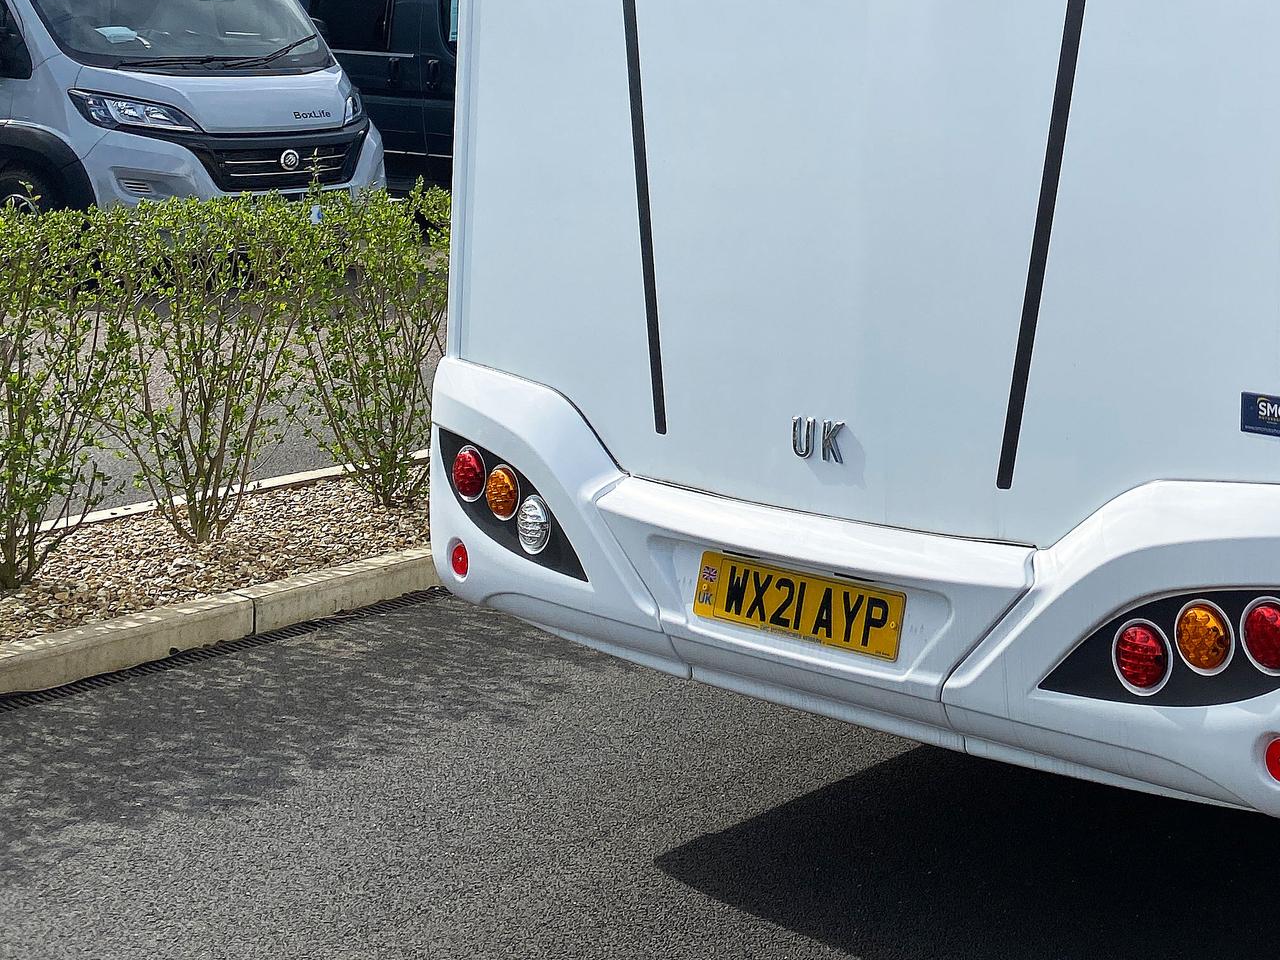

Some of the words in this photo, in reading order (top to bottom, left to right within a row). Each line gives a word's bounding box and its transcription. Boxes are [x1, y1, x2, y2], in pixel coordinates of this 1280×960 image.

[292, 109, 332, 120] BoxLife
[791, 415, 846, 464] UK
[697, 590, 714, 606] UK
[724, 565, 807, 631] WX21
[811, 587, 890, 648] AYP
